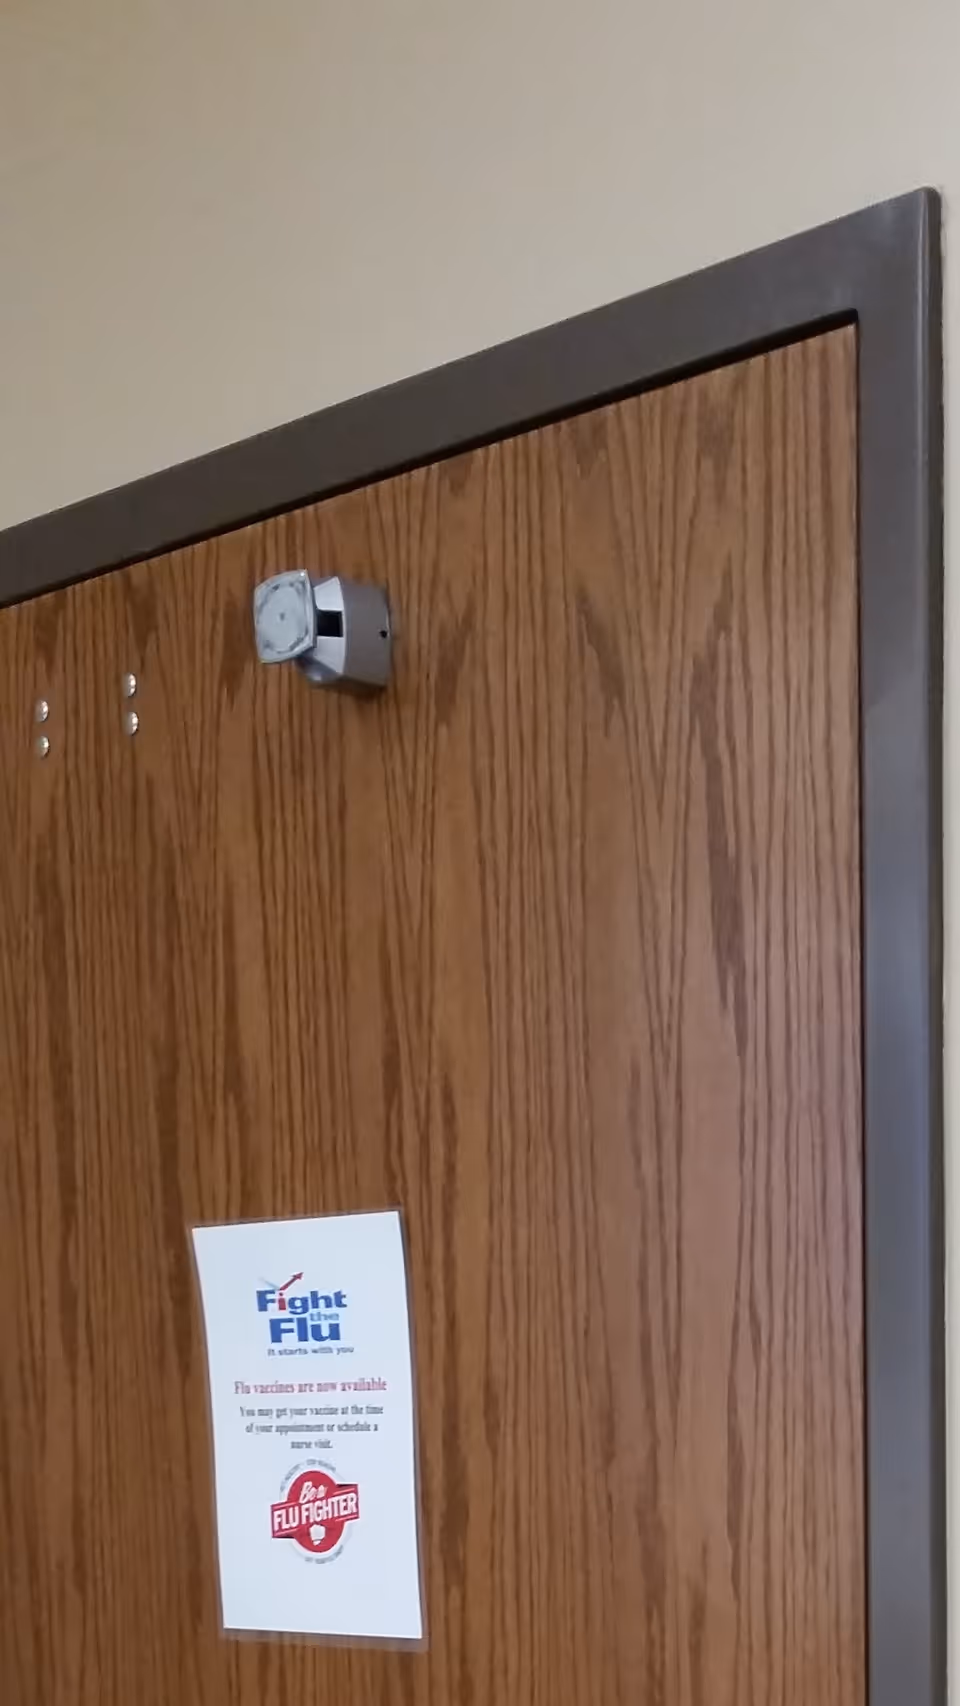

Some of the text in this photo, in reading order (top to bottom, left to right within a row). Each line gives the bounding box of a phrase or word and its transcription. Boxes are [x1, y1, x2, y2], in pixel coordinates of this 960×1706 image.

[256, 1289, 347, 1315] Fight
[310, 1312, 339, 1321] the
[269, 1317, 341, 1343] Flu
[234, 1377, 387, 1394] Flu vaccines are now available
[273, 1493, 357, 1531] FLU FIGHTER
